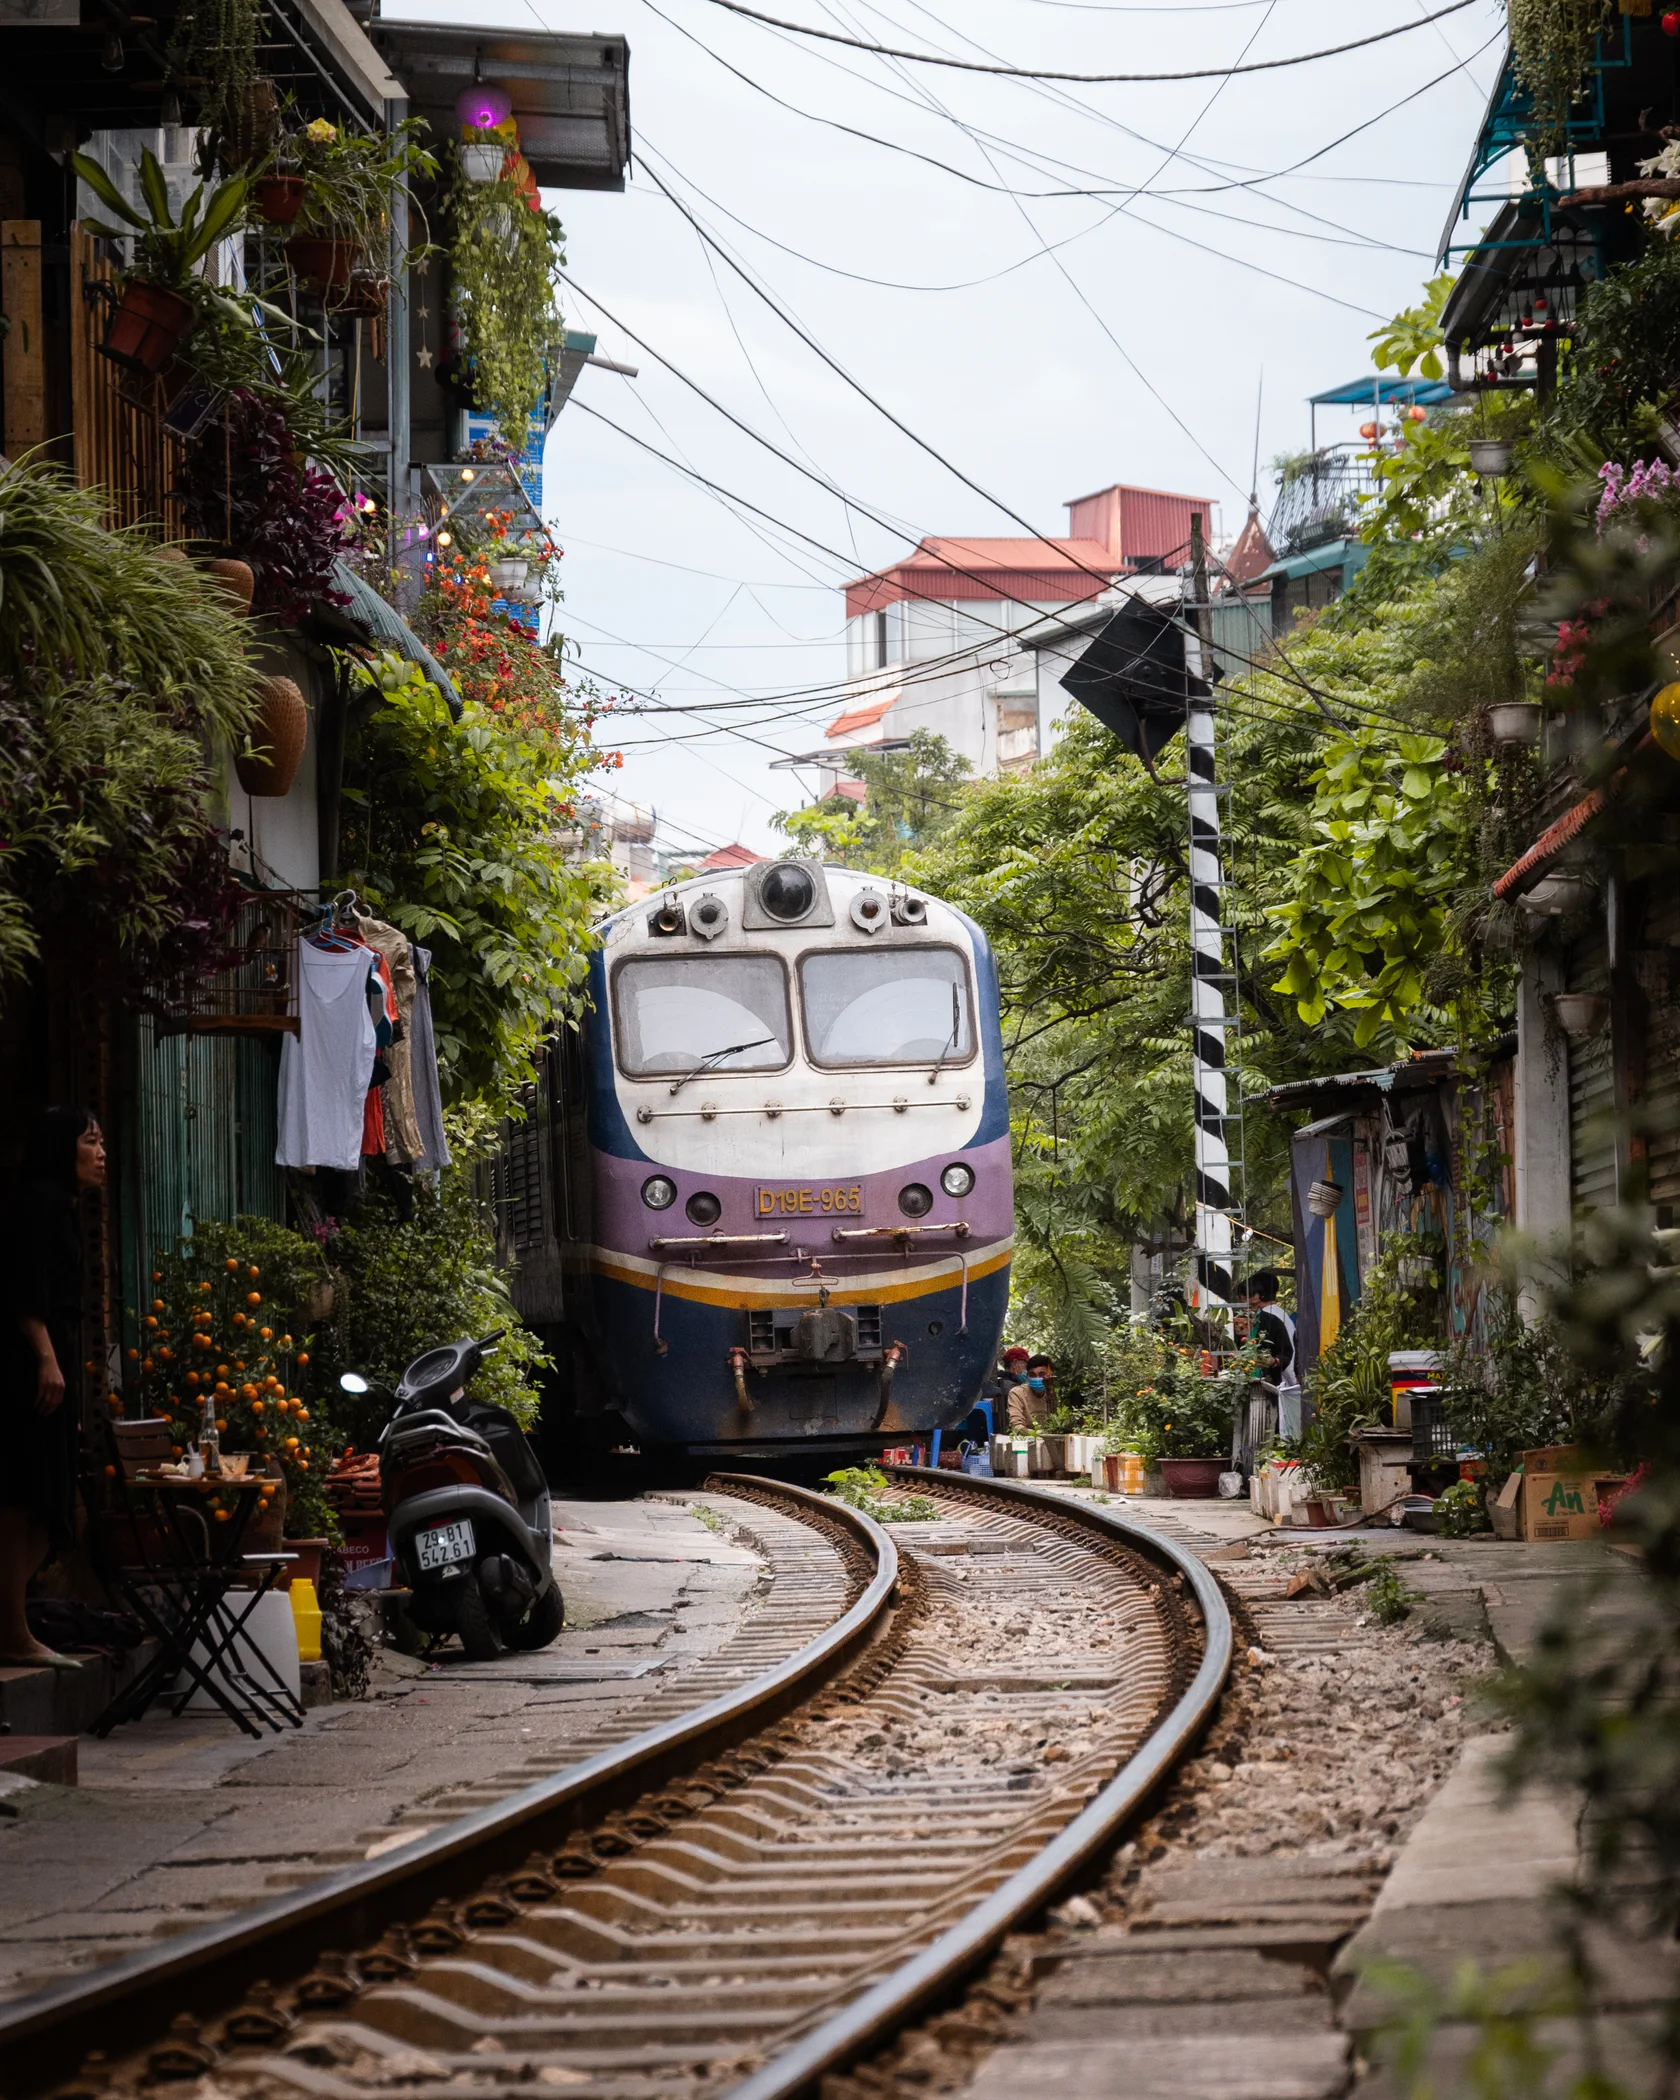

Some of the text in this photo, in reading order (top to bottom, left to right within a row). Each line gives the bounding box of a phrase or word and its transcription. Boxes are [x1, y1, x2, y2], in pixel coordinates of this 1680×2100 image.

[760, 1187, 860, 1213] D19E-965
[1541, 1481, 1585, 1516] An
[335, 1545, 370, 1555] ABECO
[421, 1540, 470, 1567] 542.61
